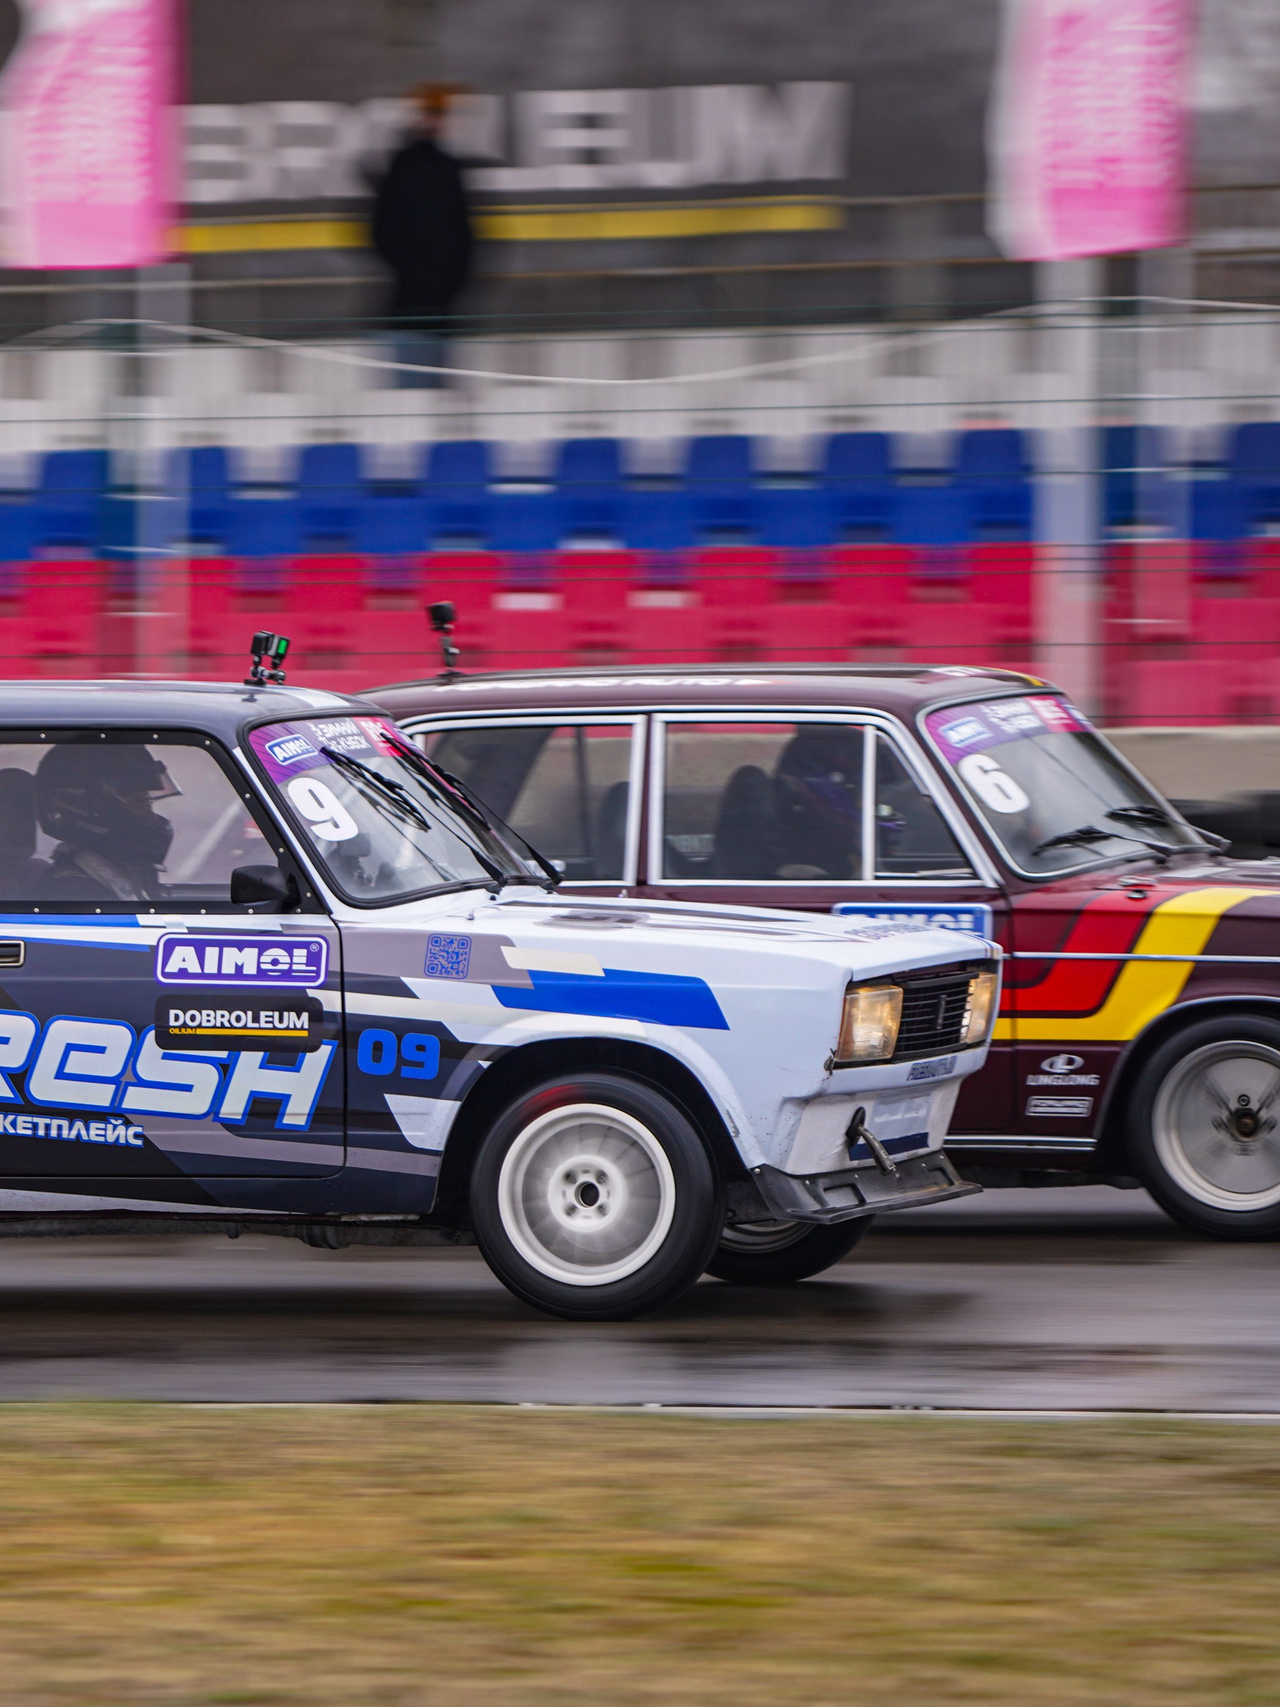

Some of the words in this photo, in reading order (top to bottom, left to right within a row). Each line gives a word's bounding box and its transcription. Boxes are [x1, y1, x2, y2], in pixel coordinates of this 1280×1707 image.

[287, 777, 359, 842] 9
[958, 754, 1030, 814] 6
[169, 1009, 309, 1029] DOBROLEUM
[358, 1028, 440, 1080] 09
